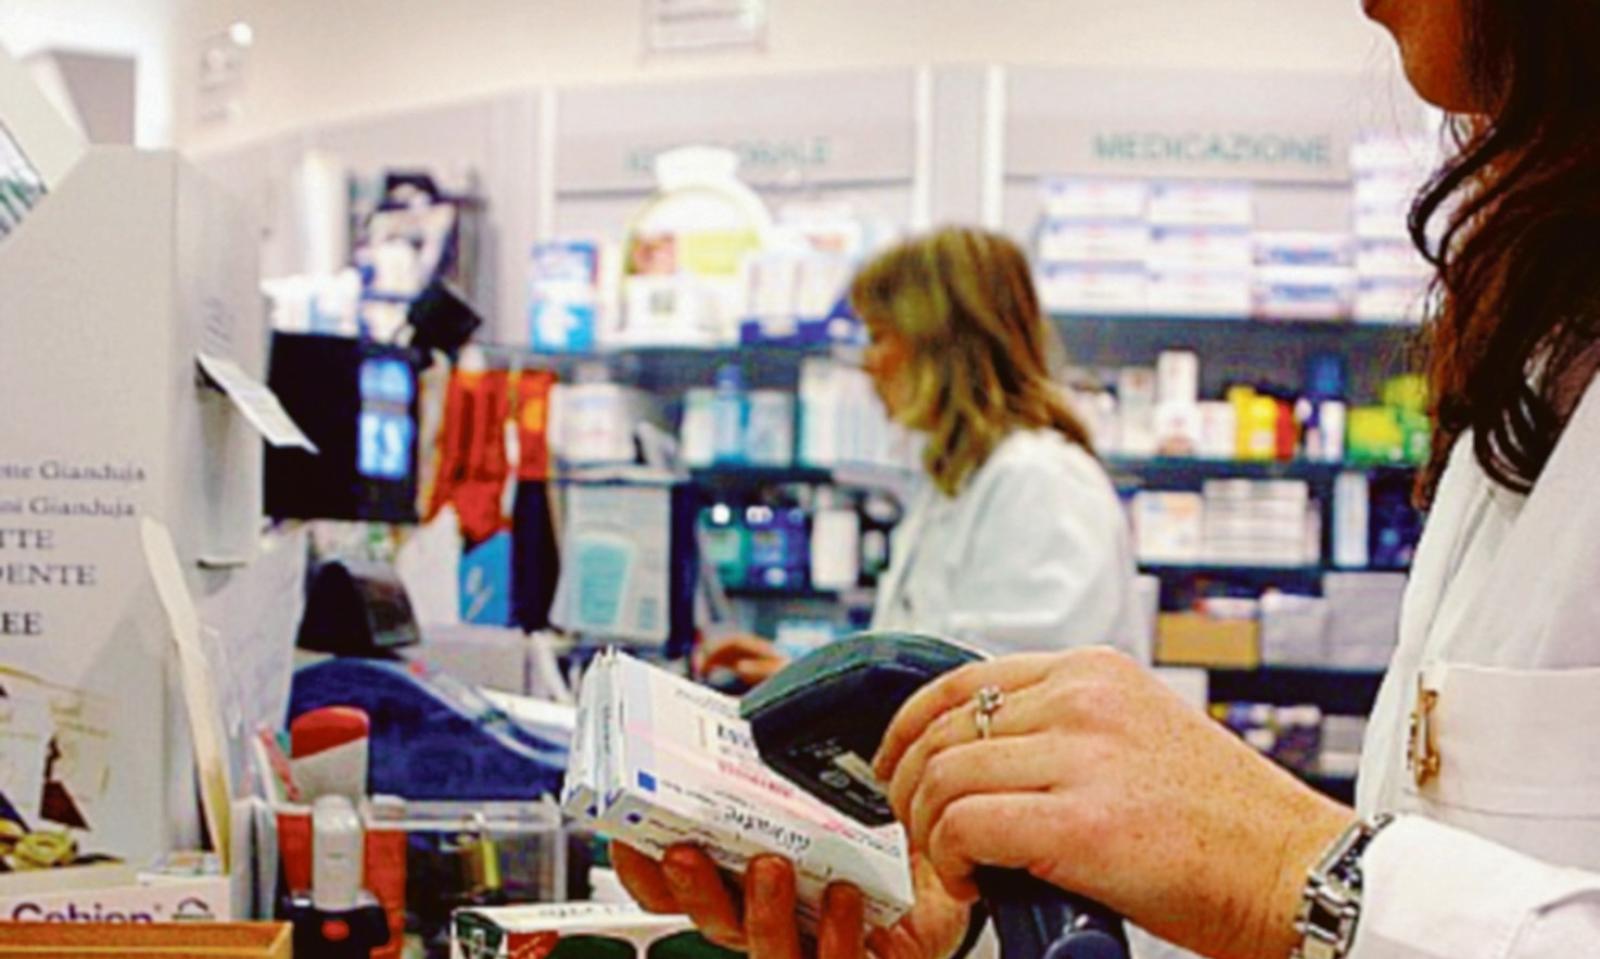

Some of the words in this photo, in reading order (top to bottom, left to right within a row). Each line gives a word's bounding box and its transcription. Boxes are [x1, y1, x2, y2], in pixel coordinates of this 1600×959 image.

[1094, 131, 1331, 164] MEDICAZIONE
[40, 460, 146, 481] Gianduja
[29, 496, 135, 518] Gianduja
